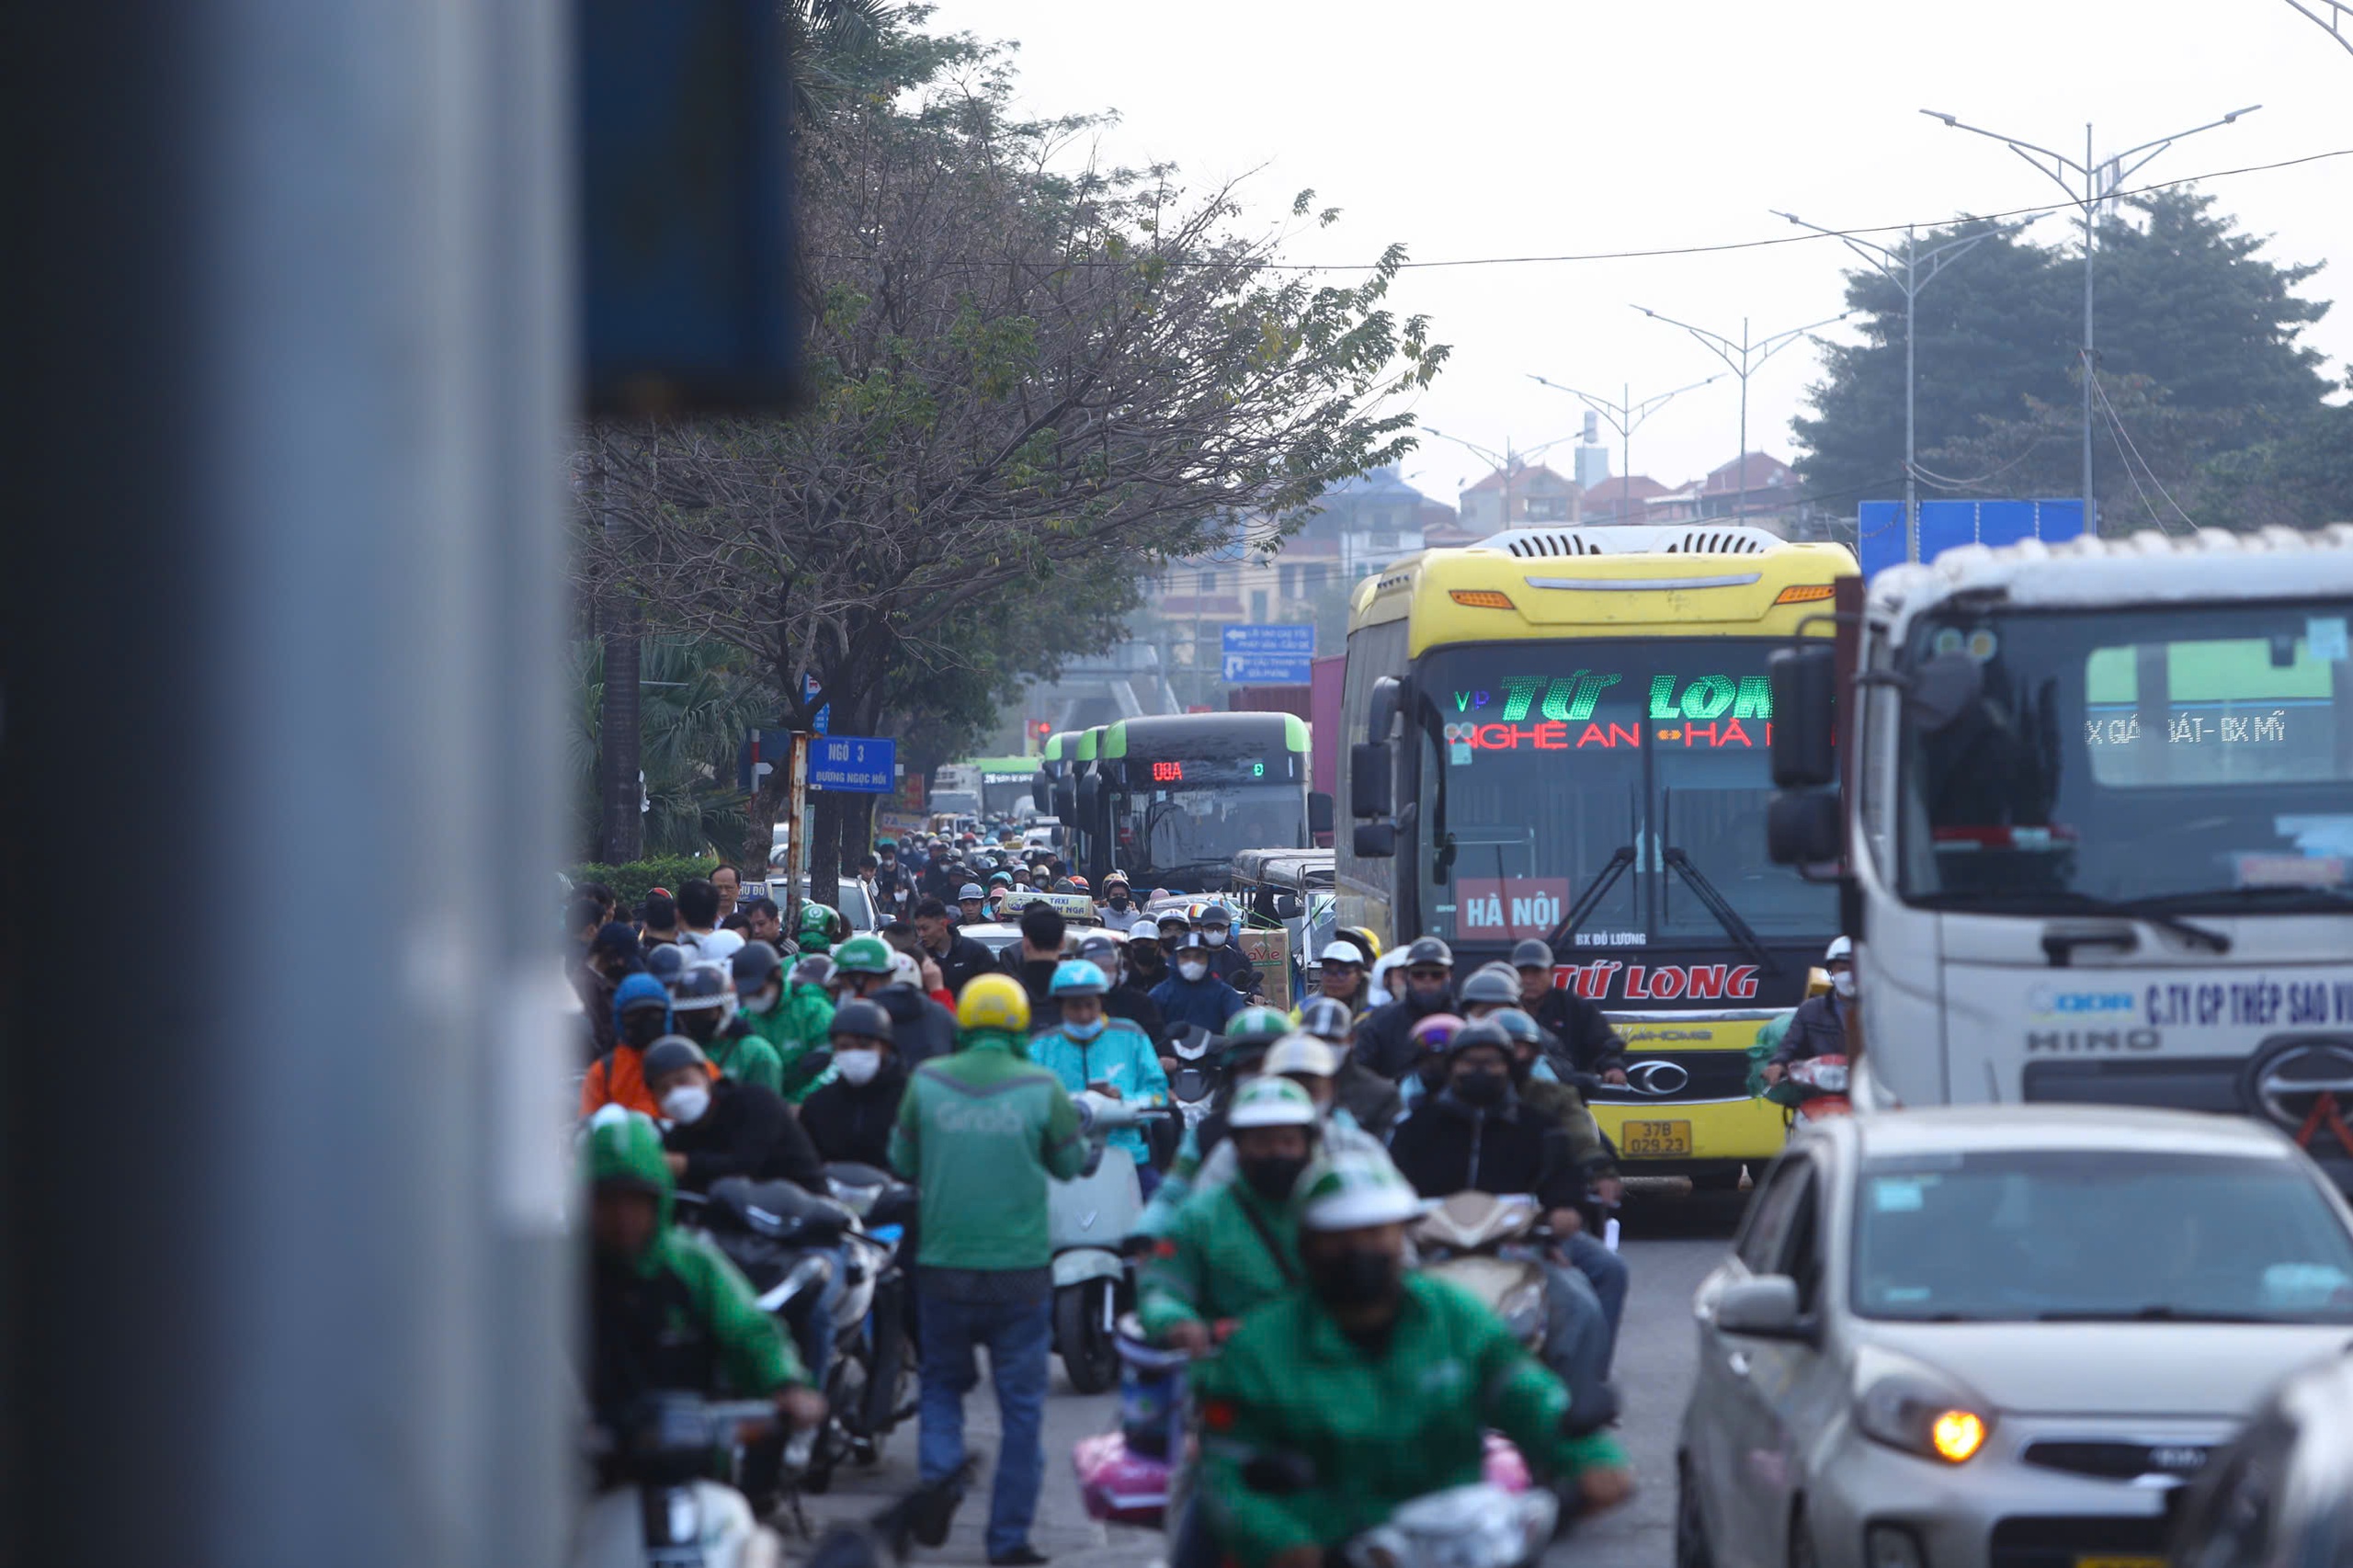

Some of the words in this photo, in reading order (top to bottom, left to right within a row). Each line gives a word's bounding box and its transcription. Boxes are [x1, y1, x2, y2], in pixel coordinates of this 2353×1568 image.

[1501, 669, 1623, 721] TỨ
[1649, 675, 1774, 719] LON
[1576, 722, 1640, 748] AN
[1685, 717, 1753, 748] HÀ
[858, 744, 864, 763] 3
[1467, 892, 1505, 926] HÀ
[1512, 891, 1560, 931] NỘI
[1575, 933, 1591, 946] BX
[1247, 948, 1280, 960] aVie
[1552, 959, 1623, 1000] TỨ
[1623, 964, 1760, 1000] LONG
[2026, 1028, 2163, 1052] HINO
[1643, 1121, 1672, 1137] 37B
